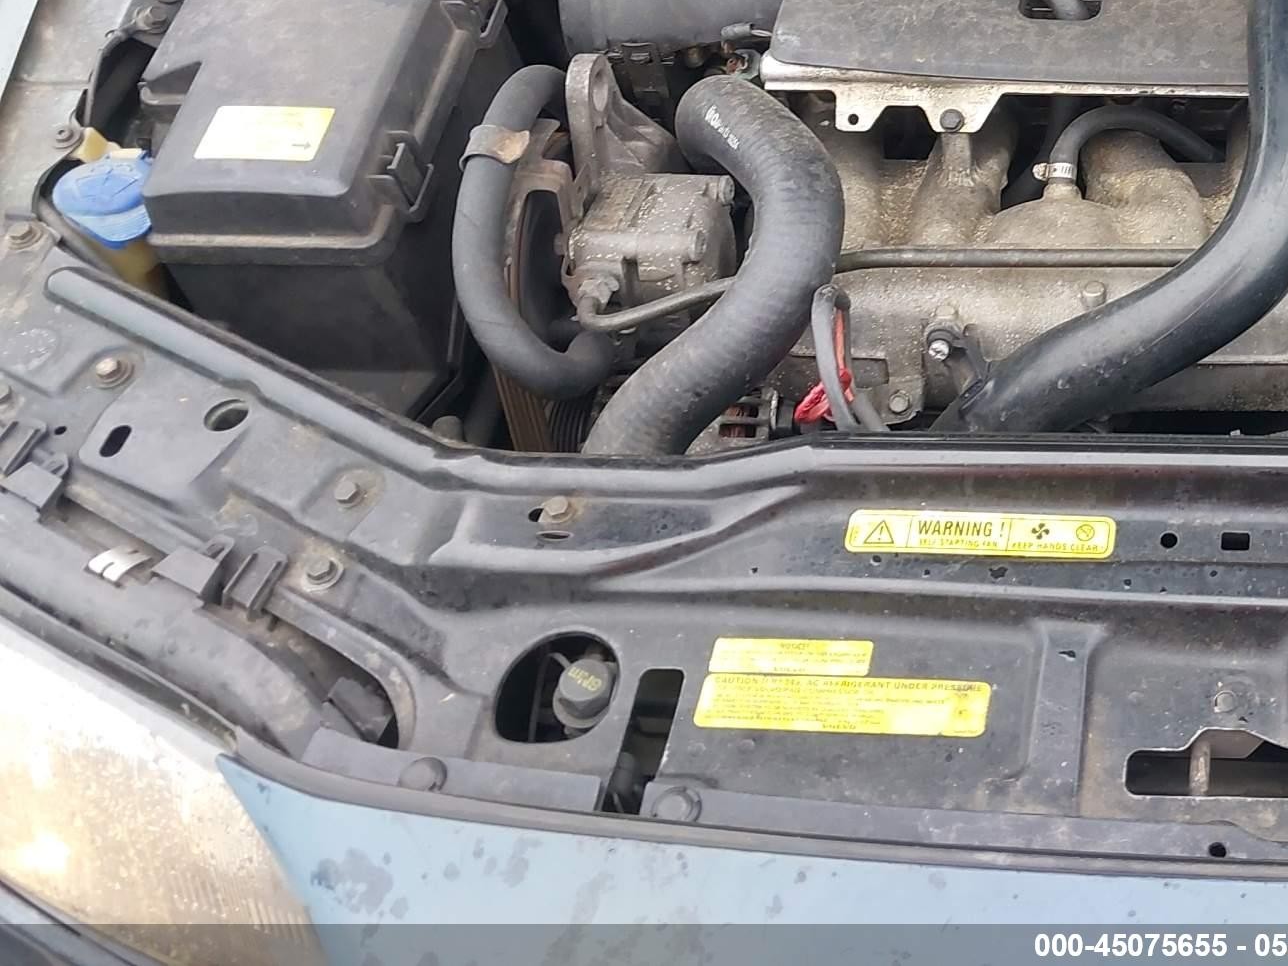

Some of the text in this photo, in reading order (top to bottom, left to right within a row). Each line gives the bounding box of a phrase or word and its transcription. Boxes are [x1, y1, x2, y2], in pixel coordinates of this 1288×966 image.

[918, 520, 993, 536] WARNING
[714, 676, 759, 685] CAUTION
[894, 682, 928, 690] UNDER
